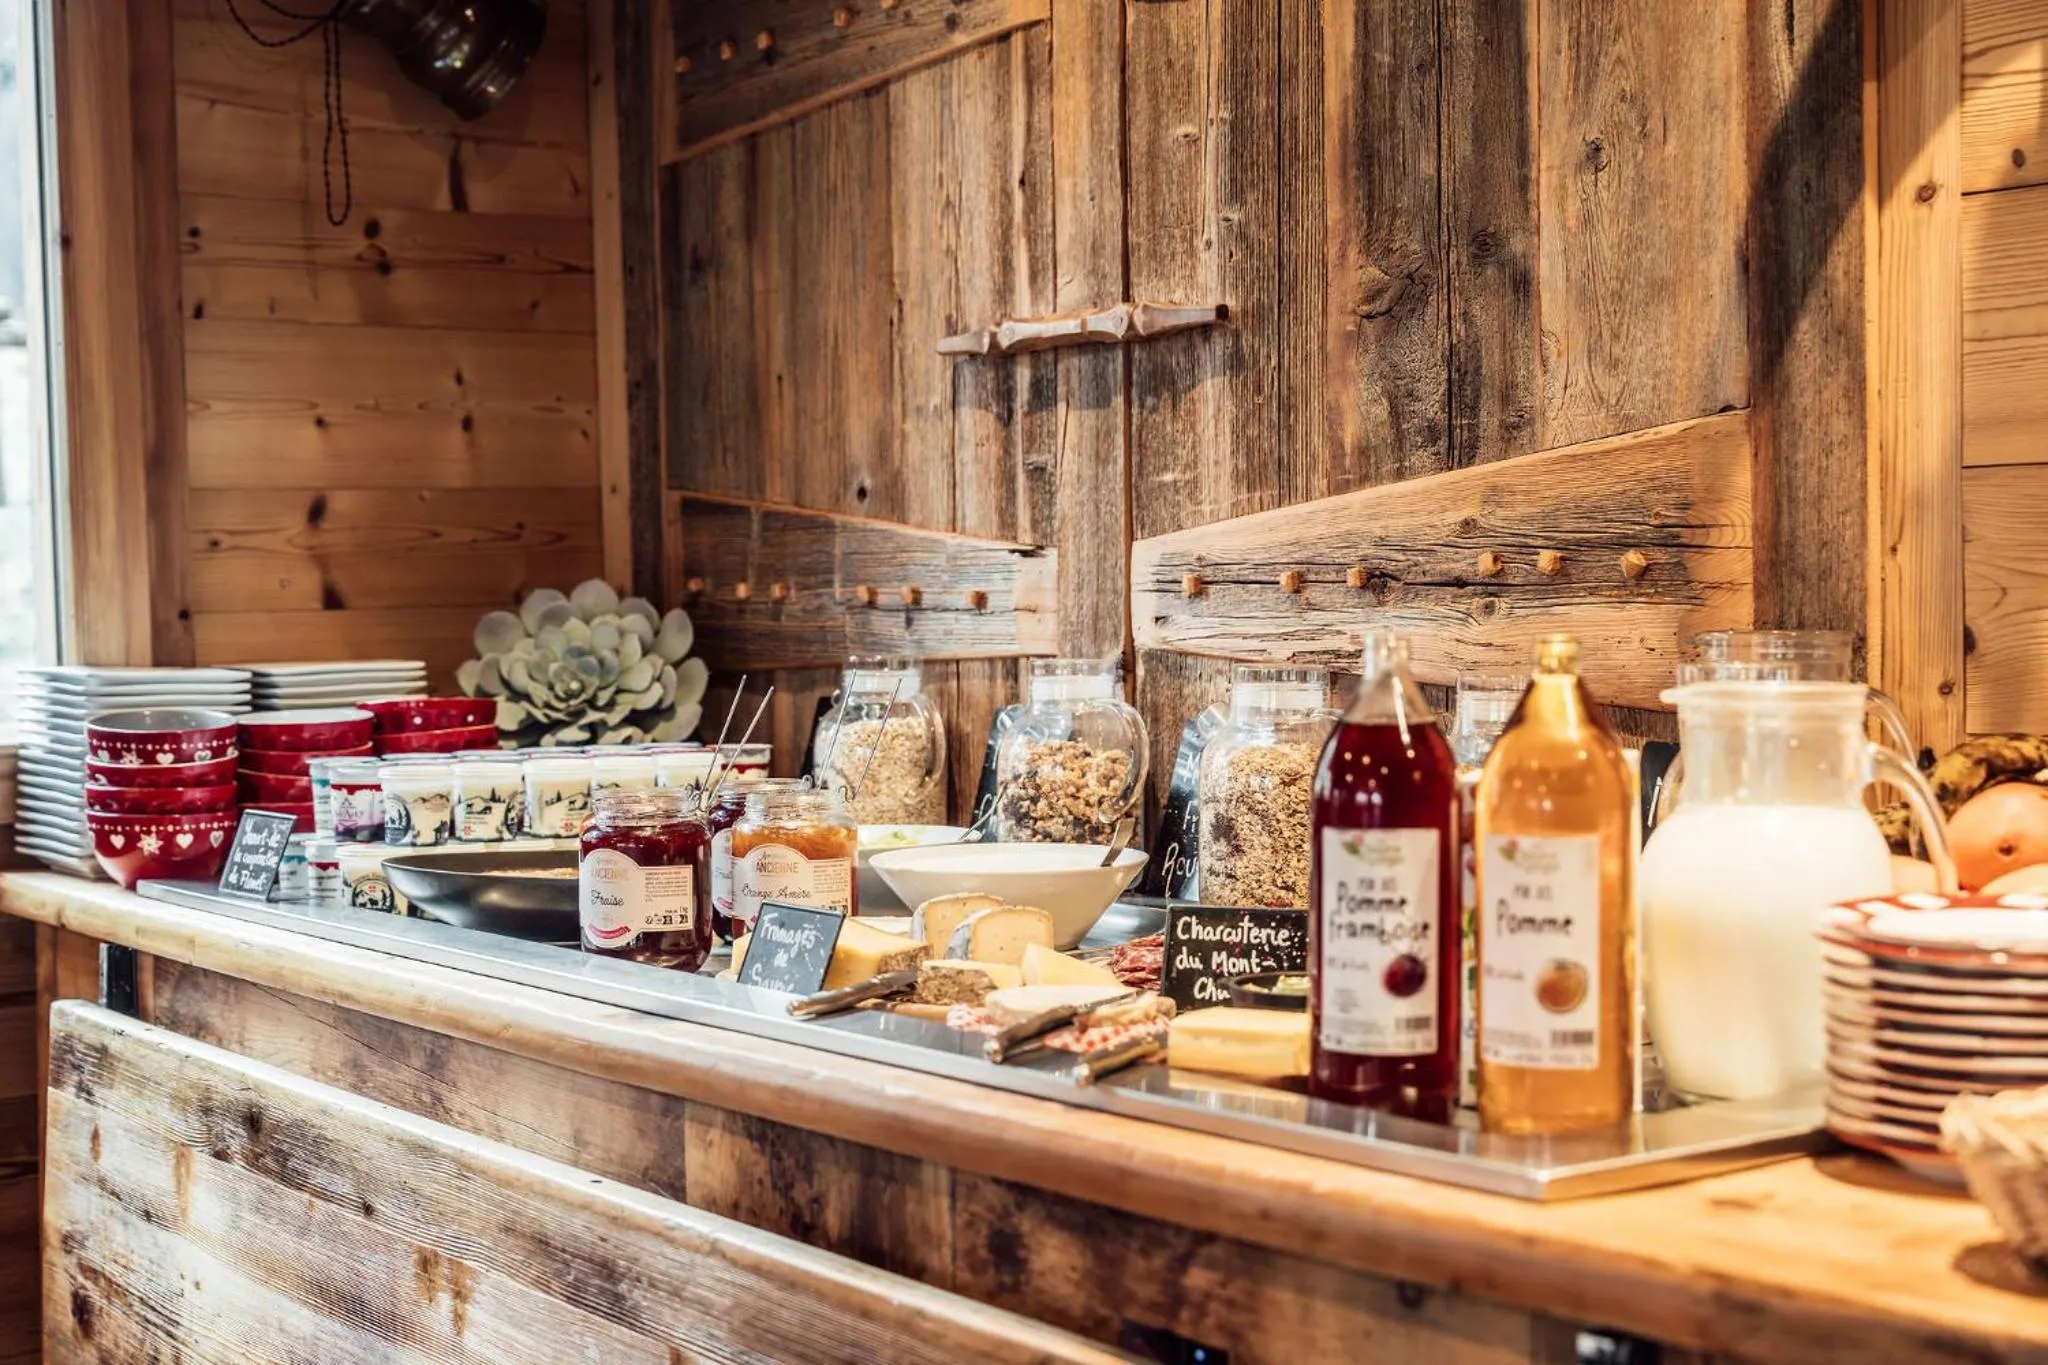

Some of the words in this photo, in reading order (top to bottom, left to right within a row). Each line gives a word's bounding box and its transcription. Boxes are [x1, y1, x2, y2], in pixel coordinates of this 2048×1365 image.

[590, 889, 625, 906] Fraise
[1336, 880, 1408, 916] Pomme
[1176, 914, 1292, 946] Charcuterie
[1496, 897, 1574, 937] Pomme
[1175, 945, 1204, 970] du
